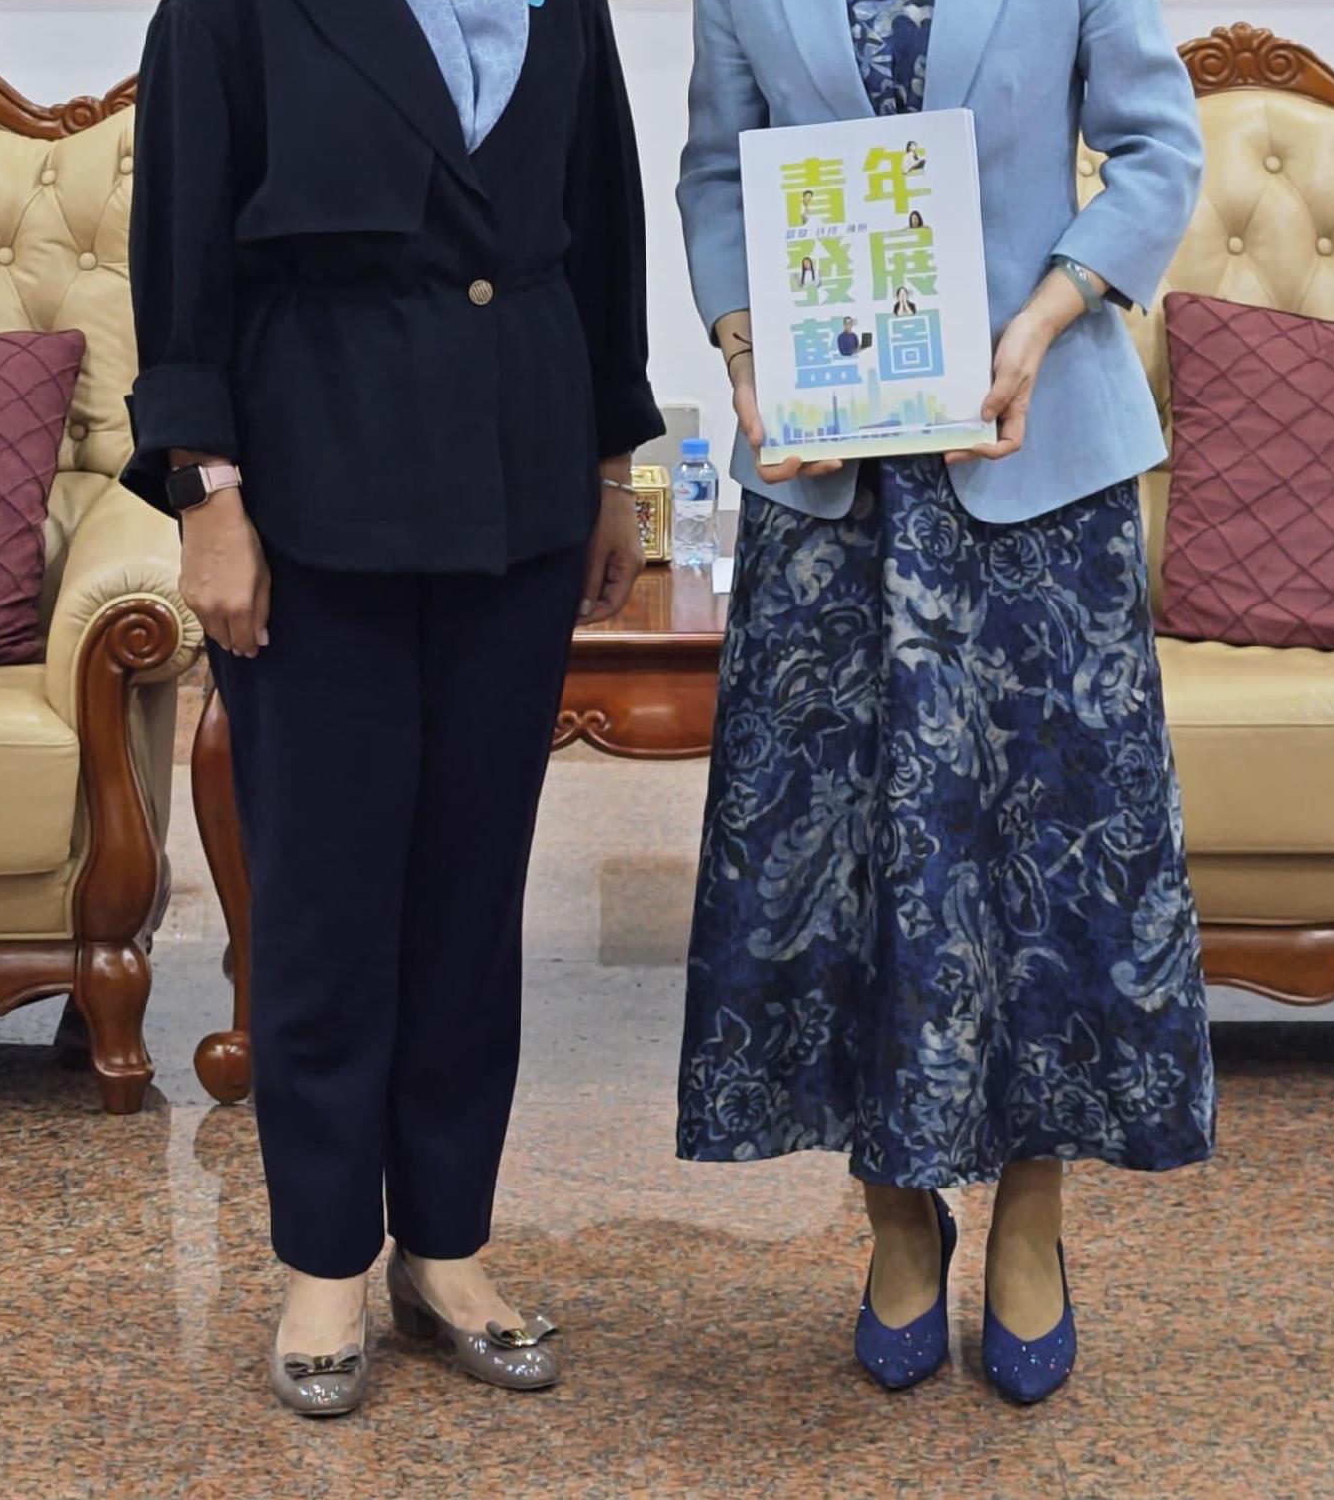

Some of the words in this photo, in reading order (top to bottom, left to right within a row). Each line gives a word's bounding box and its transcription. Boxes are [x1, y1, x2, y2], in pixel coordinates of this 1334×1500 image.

[780, 147, 932, 227] 青年
[785, 227, 939, 307] 發展
[790, 308, 945, 389] 藍圖
